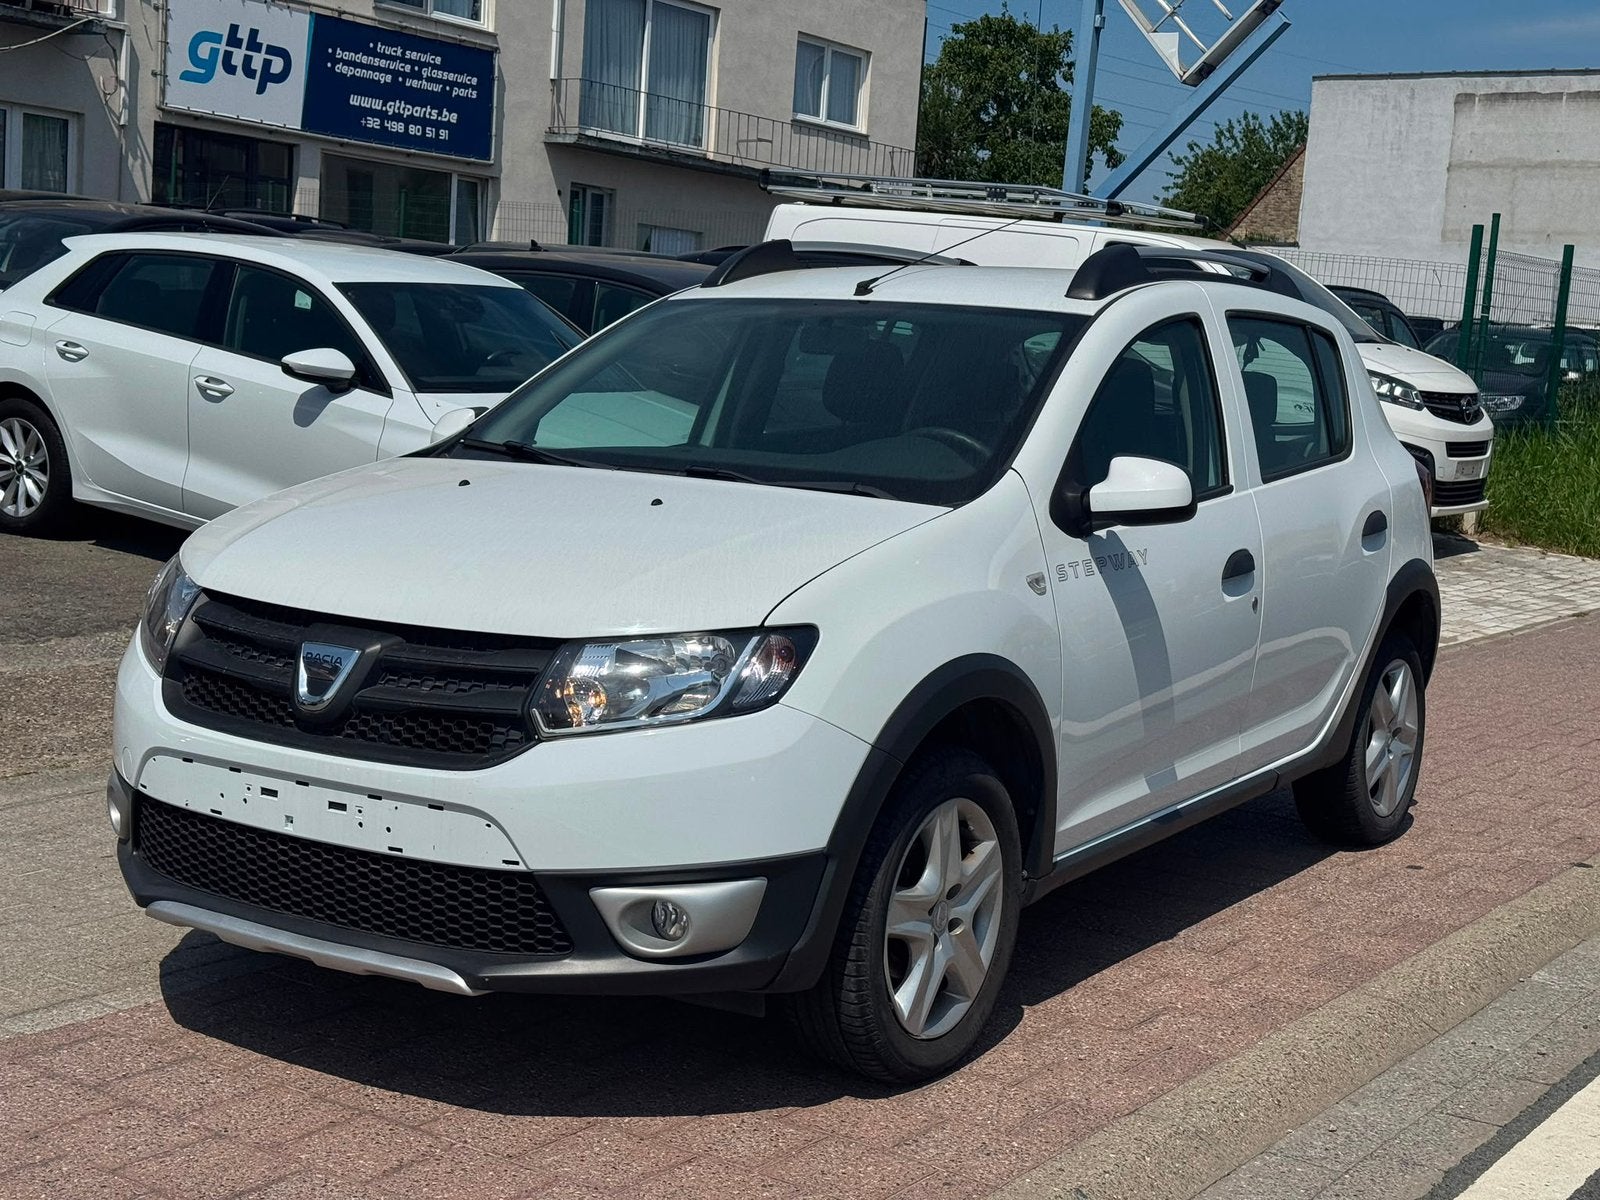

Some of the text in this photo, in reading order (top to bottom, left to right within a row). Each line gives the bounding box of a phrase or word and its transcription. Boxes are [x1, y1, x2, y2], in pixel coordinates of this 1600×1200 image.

[179, 23, 292, 95] gttp
[336, 48, 478, 86] bandenservice glasservice
[377, 42, 442, 65] truck service
[335, 63, 478, 99] depannage verhuur parts
[350, 94, 458, 124] www.gttparts.be
[361, 117, 449, 141] +32 498 80 51 91
[1055, 548, 1148, 582] STEPWAY
[305, 652, 343, 667] DACIA
